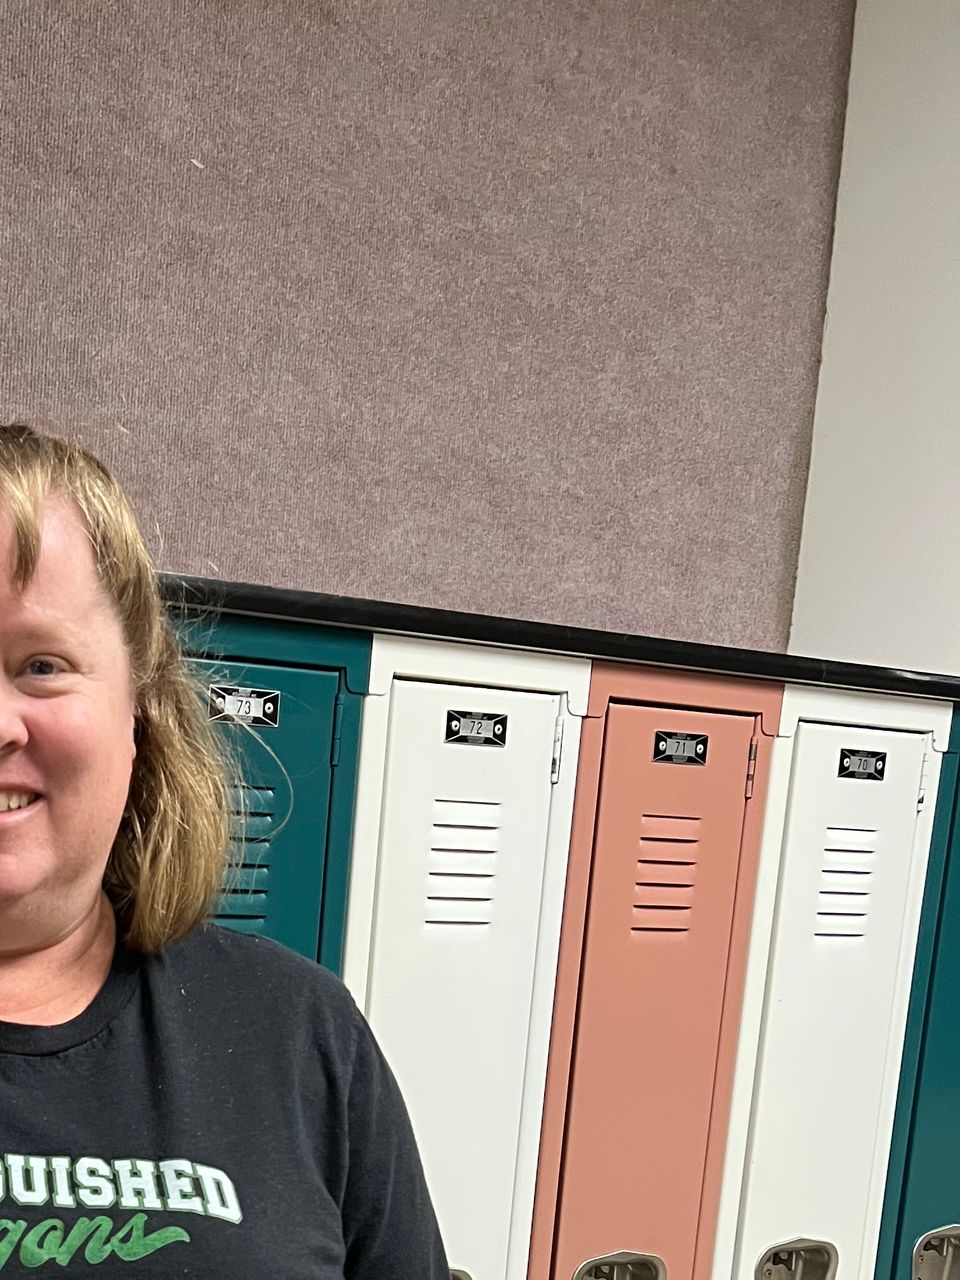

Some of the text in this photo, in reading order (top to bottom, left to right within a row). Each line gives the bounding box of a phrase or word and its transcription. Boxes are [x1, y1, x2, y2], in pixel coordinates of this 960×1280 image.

[236, 699, 251, 715] 73
[469, 720, 483, 735] 72
[674, 740, 686, 755] 71
[857, 758, 868, 771] 70
